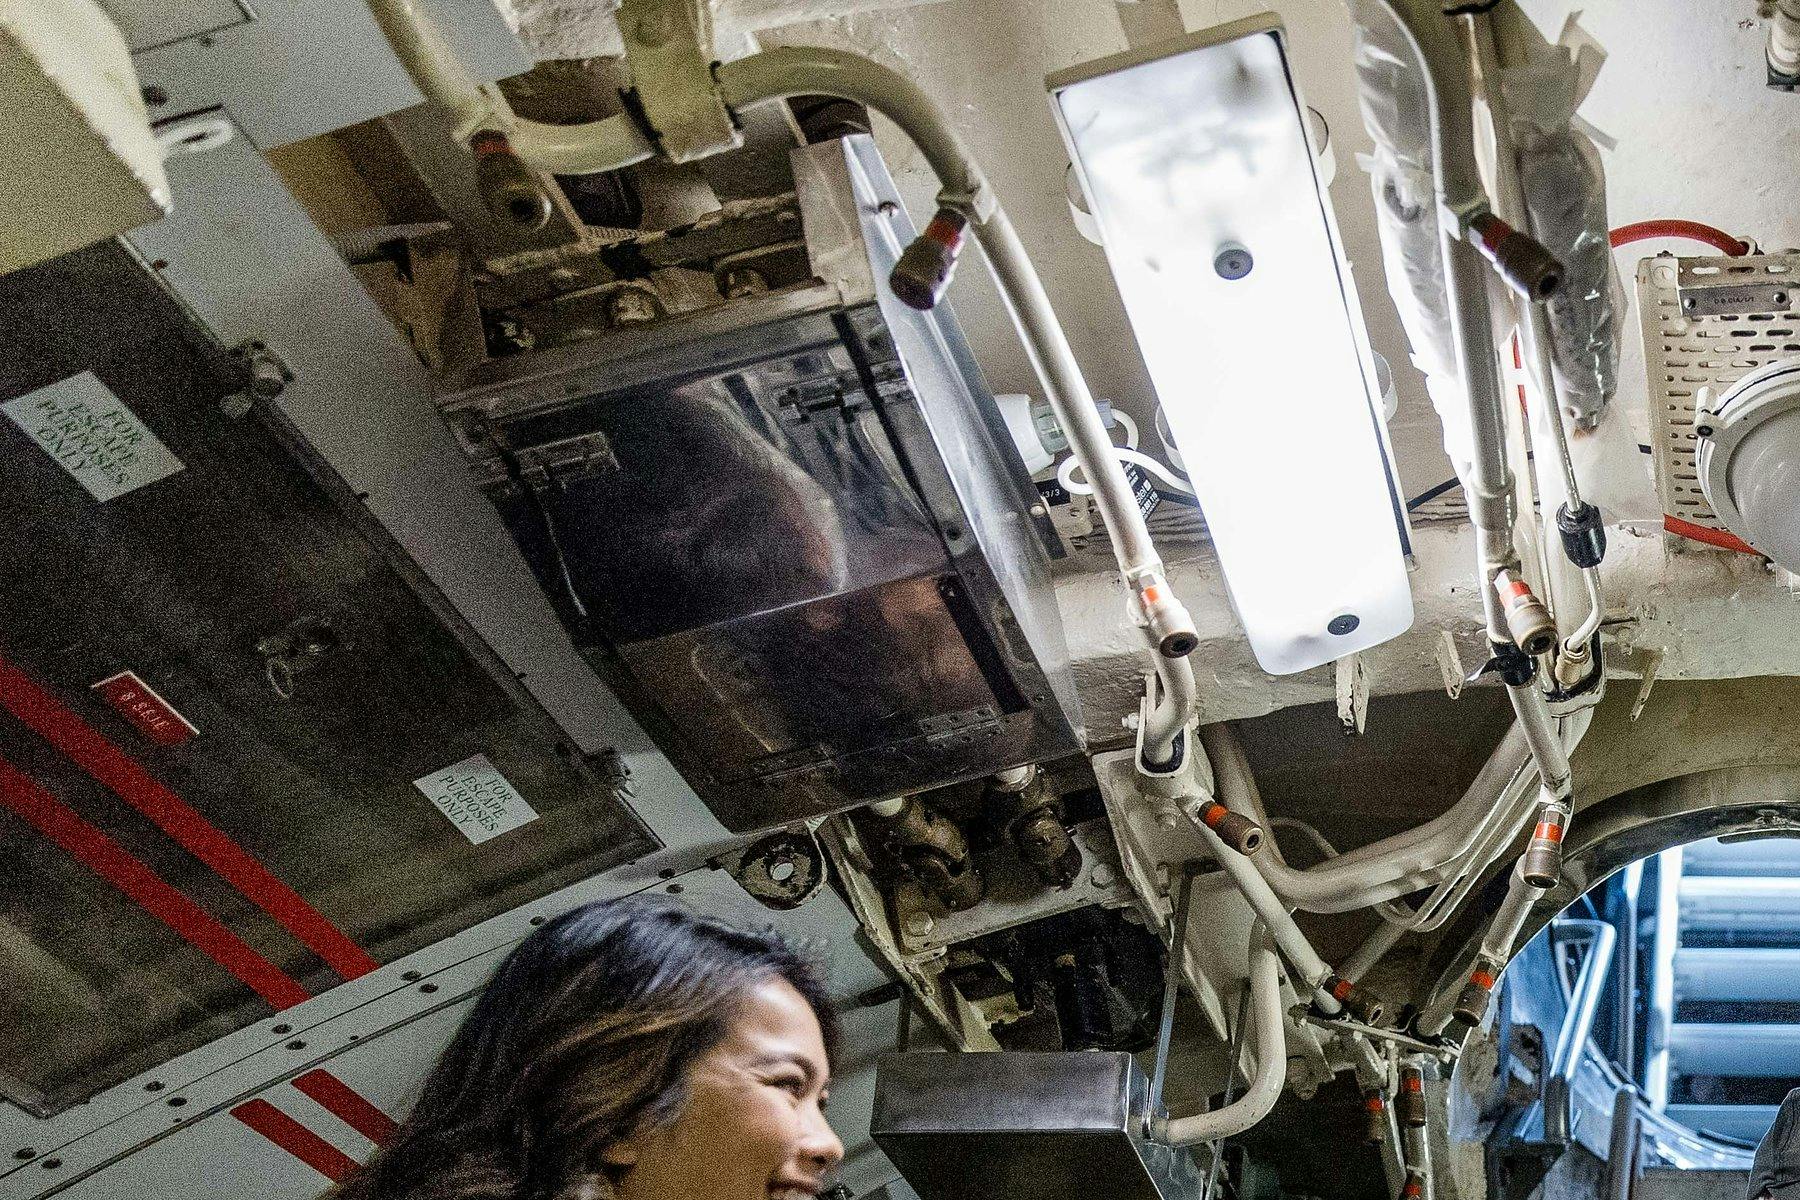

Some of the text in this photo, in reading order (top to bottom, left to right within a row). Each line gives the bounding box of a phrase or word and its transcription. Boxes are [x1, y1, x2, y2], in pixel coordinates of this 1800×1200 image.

[37, 400, 130, 485] PURPOSES
[38, 427, 91, 471] ONLY
[69, 403, 138, 466] ESCAPE
[104, 410, 143, 445] FOR
[437, 794, 473, 826] ONLY
[440, 775, 500, 832] PURPOSES
[460, 775, 507, 819] ESCAPE
[485, 777, 513, 804] FOR
